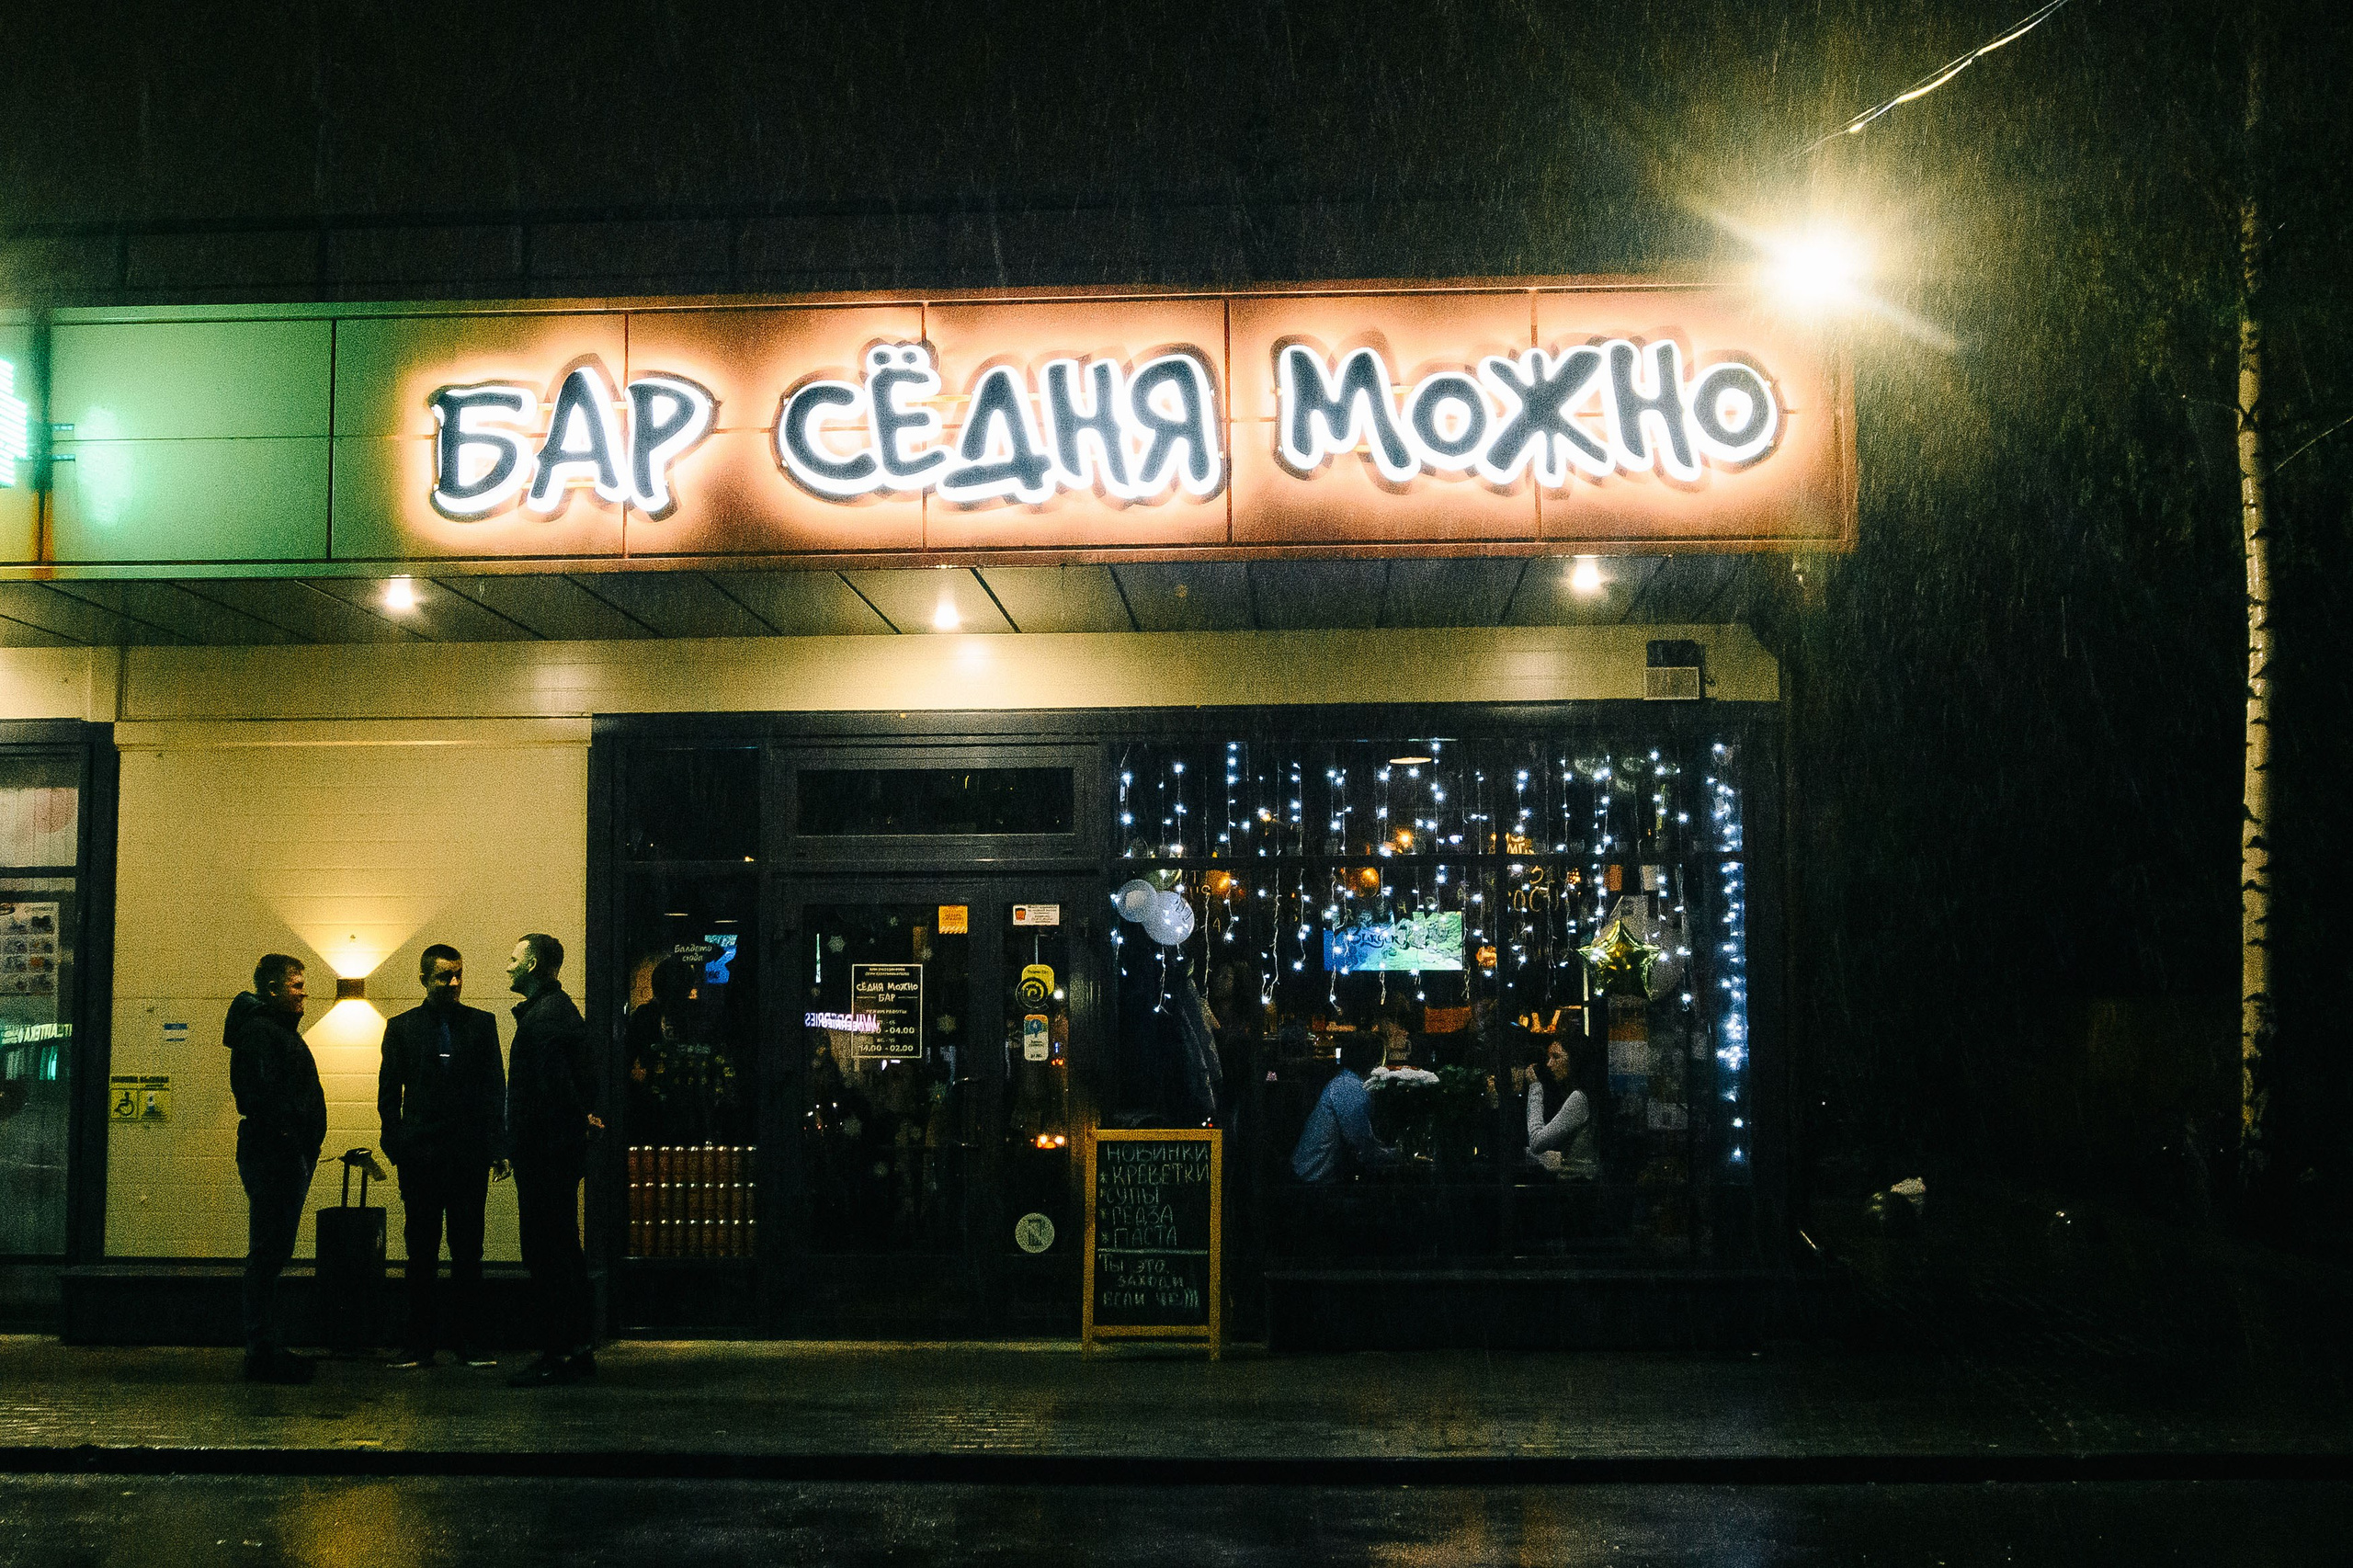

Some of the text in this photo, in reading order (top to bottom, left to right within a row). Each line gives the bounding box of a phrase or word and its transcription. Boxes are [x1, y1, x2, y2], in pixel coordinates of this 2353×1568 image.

[432, 338, 1778, 515] БАР СЁДНЯ МОЖНО
[856, 982, 884, 992] СЁДНЯ
[878, 993, 896, 1002] БАР
[1107, 1143, 1209, 1163] НОВИНКИ
[1112, 1163, 1211, 1185] КРЕВЕТКИ
[1106, 1187, 1159, 1204] СУПЫ
[1113, 1226, 1177, 1248] ПАСТА
